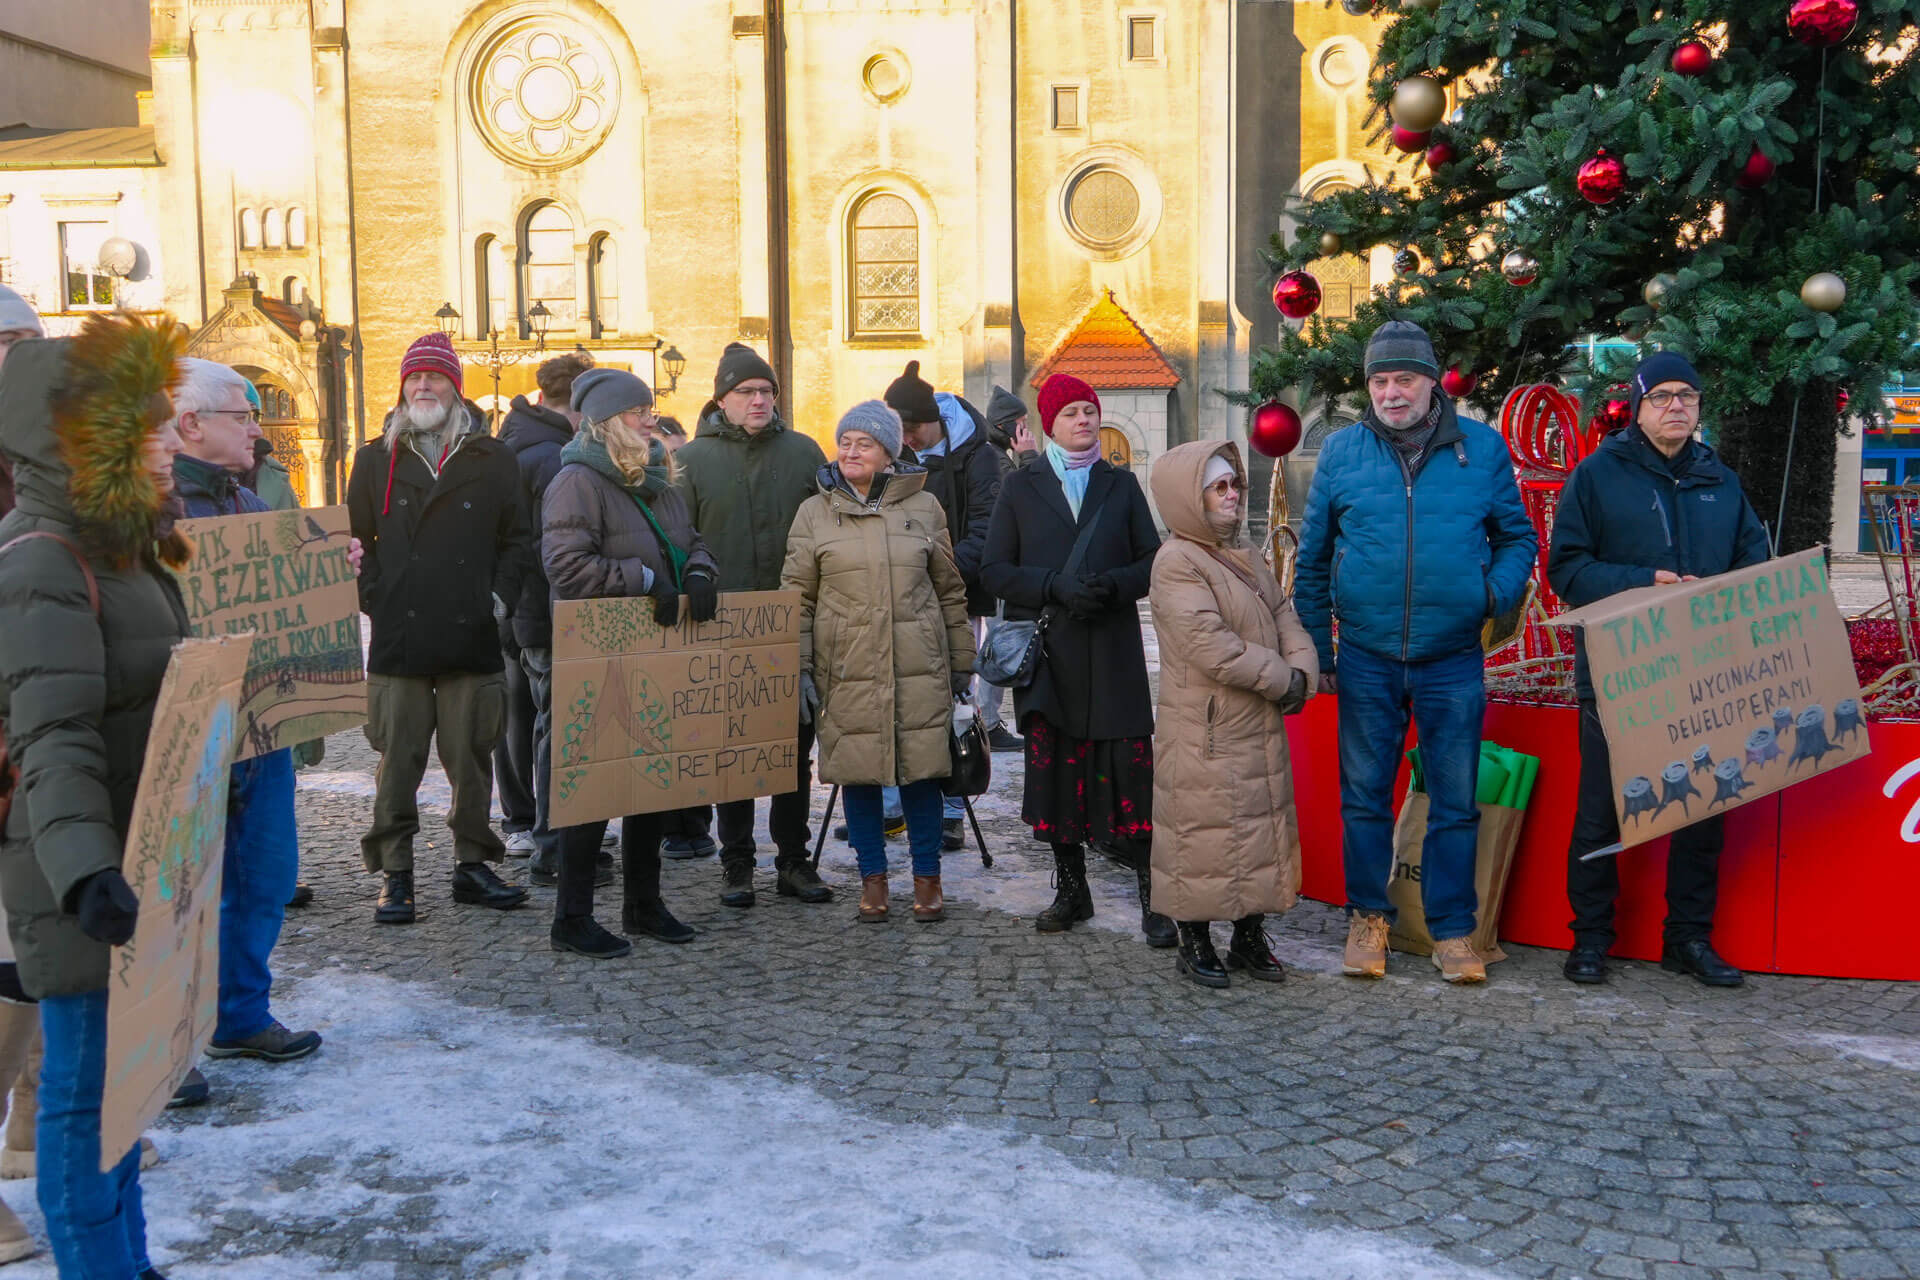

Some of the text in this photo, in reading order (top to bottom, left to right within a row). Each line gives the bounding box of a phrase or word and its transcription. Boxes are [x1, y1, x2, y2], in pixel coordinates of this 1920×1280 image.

[245, 522, 270, 559] dla
[274, 604, 308, 631] DLA
[1602, 555, 1828, 660] TAK REZERWAT
[672, 674, 797, 719] REZERWATU
[1616, 642, 1812, 735] PRZED WYCINKAMI I
[728, 714, 748, 738] W
[1667, 676, 1812, 745] DEWELOPERAMI
[678, 744, 795, 782] REPTACH
